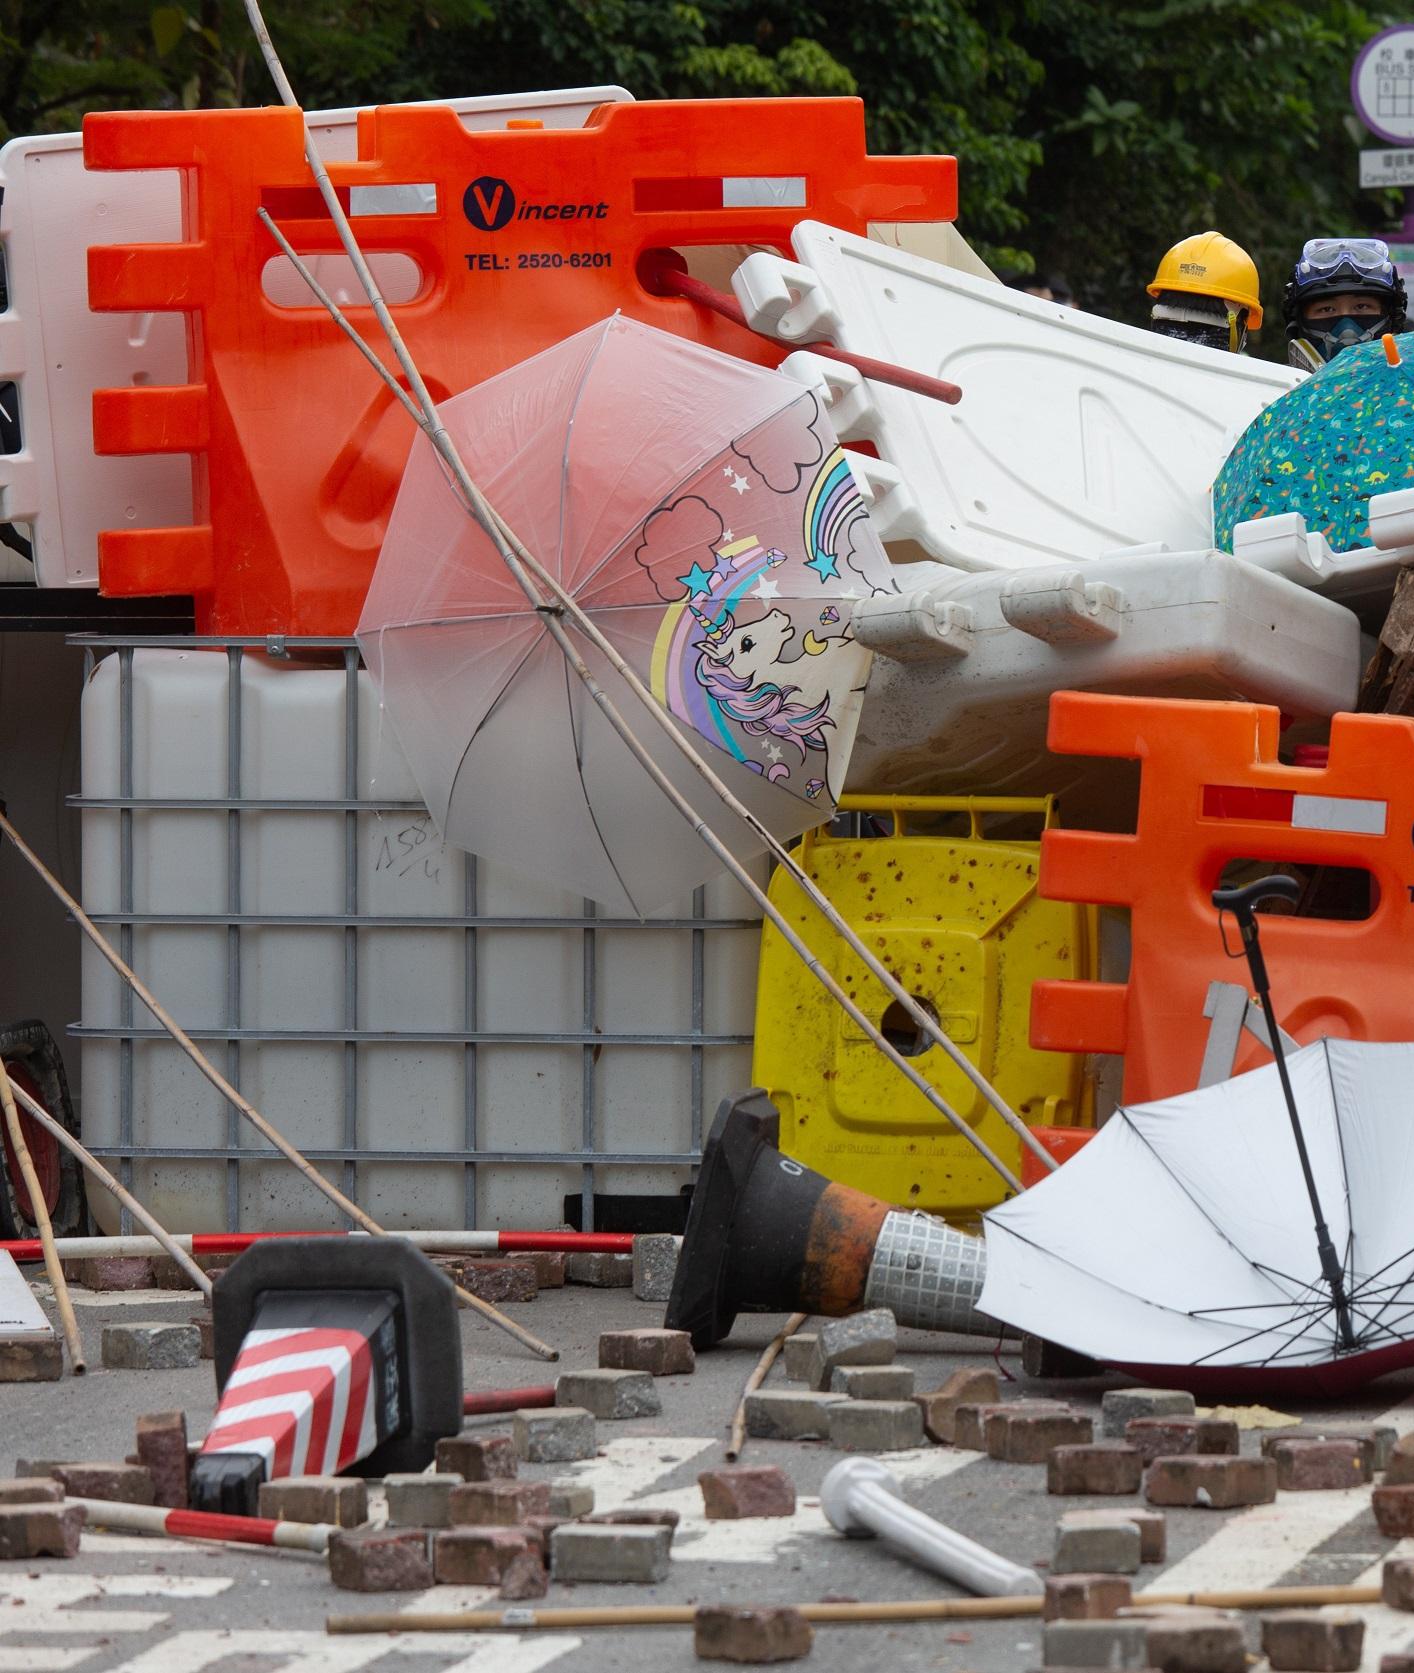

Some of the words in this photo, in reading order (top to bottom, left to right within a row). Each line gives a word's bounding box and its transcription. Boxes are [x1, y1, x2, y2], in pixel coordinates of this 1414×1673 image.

[1375, 63, 1405, 75] BUS
[464, 177, 609, 231] Vincent
[465, 254, 510, 270] TEL:
[518, 253, 611, 269] 2520-6201
